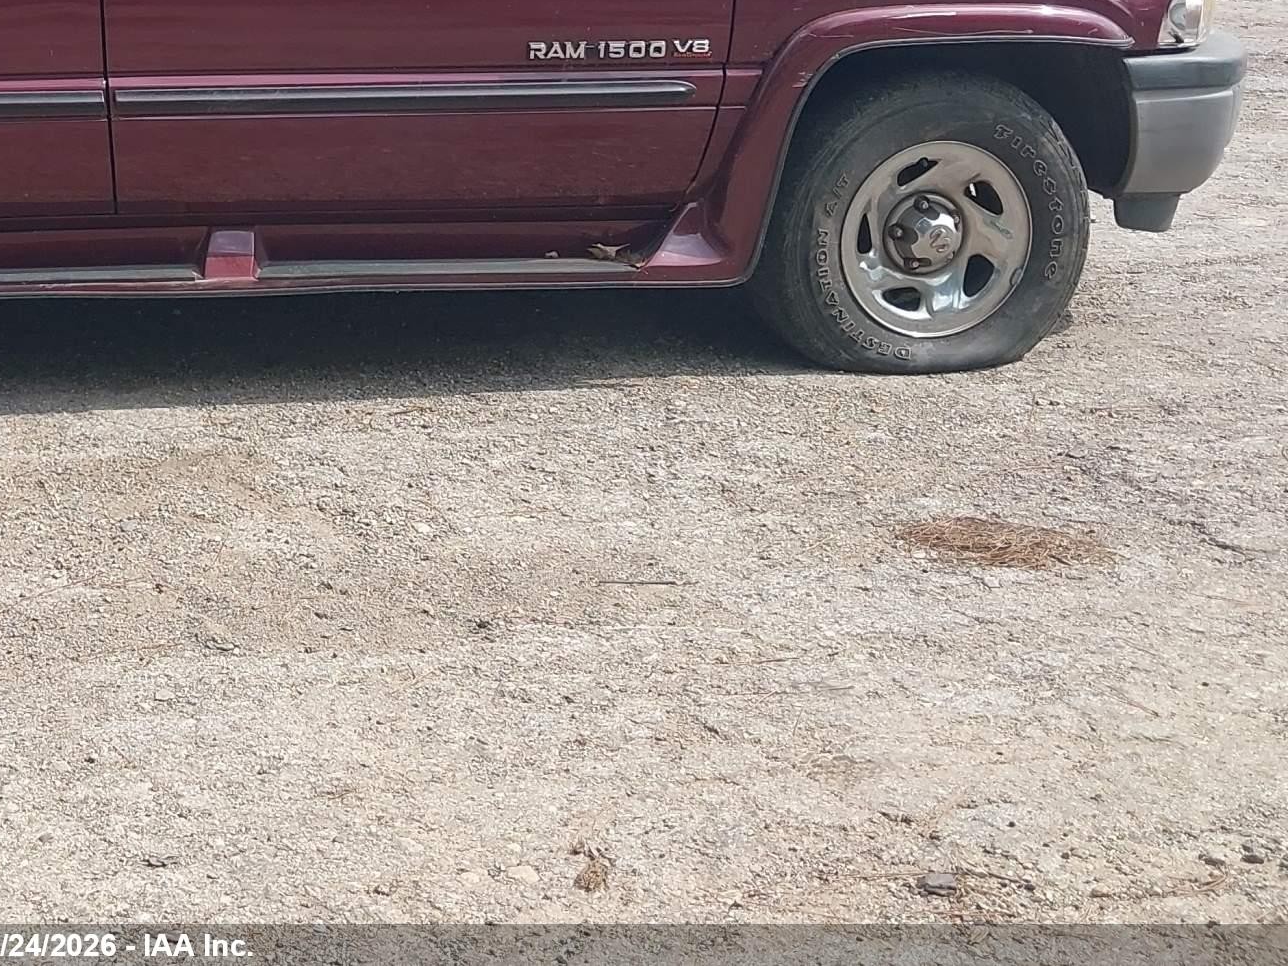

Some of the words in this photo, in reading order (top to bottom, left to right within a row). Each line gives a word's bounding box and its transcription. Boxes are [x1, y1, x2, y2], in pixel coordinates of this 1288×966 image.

[528, 41, 586, 59] RAM
[598, 40, 666, 58] 1500
[672, 39, 710, 53] V8
[816, 228, 912, 360] DESTINATION
